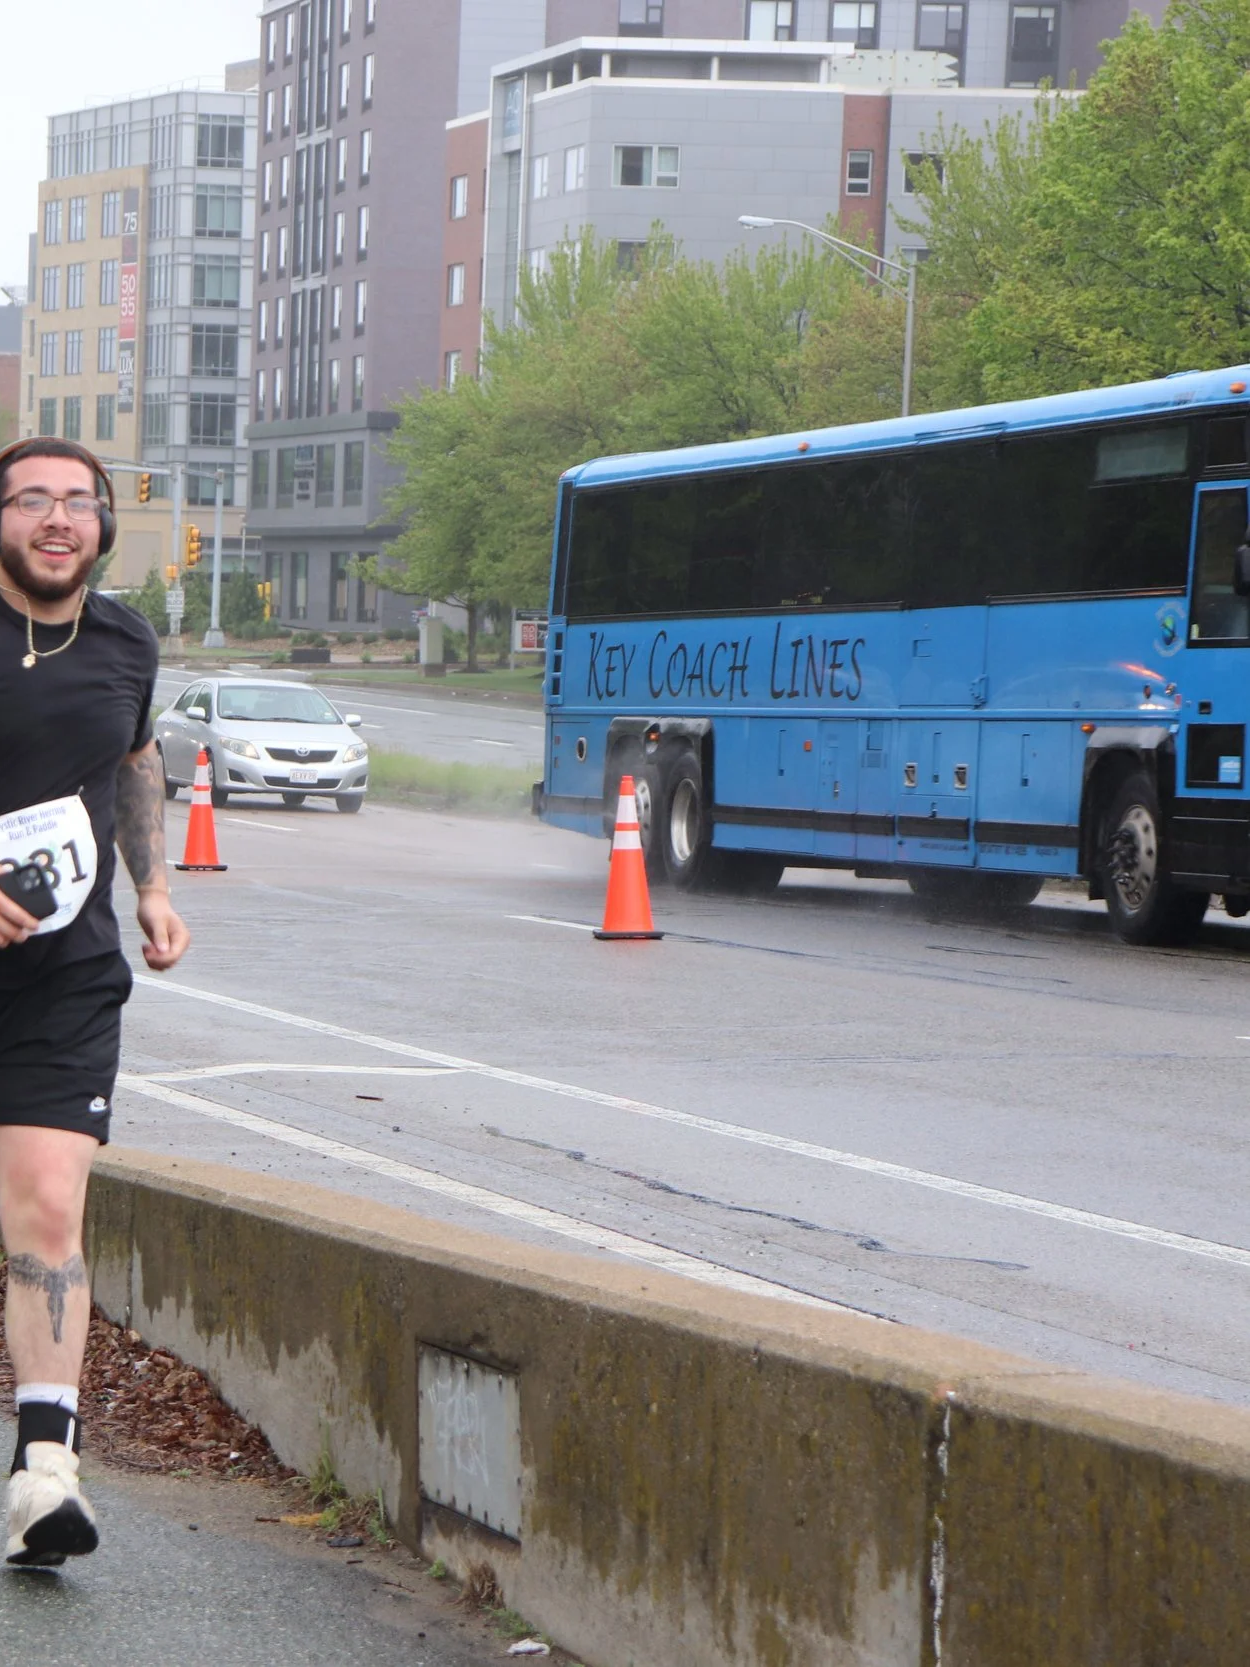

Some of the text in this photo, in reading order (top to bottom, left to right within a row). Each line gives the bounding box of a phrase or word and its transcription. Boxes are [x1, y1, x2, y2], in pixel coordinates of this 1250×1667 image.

[123, 212, 138, 232] 75
[121, 275, 136, 294] 50
[121, 298, 135, 317] 55
[118, 356, 134, 375] LUX
[17, 813, 38, 826] River
[38, 805, 67, 819] Herring
[8, 830, 25, 841] Run
[32, 820, 58, 834] Paddle
